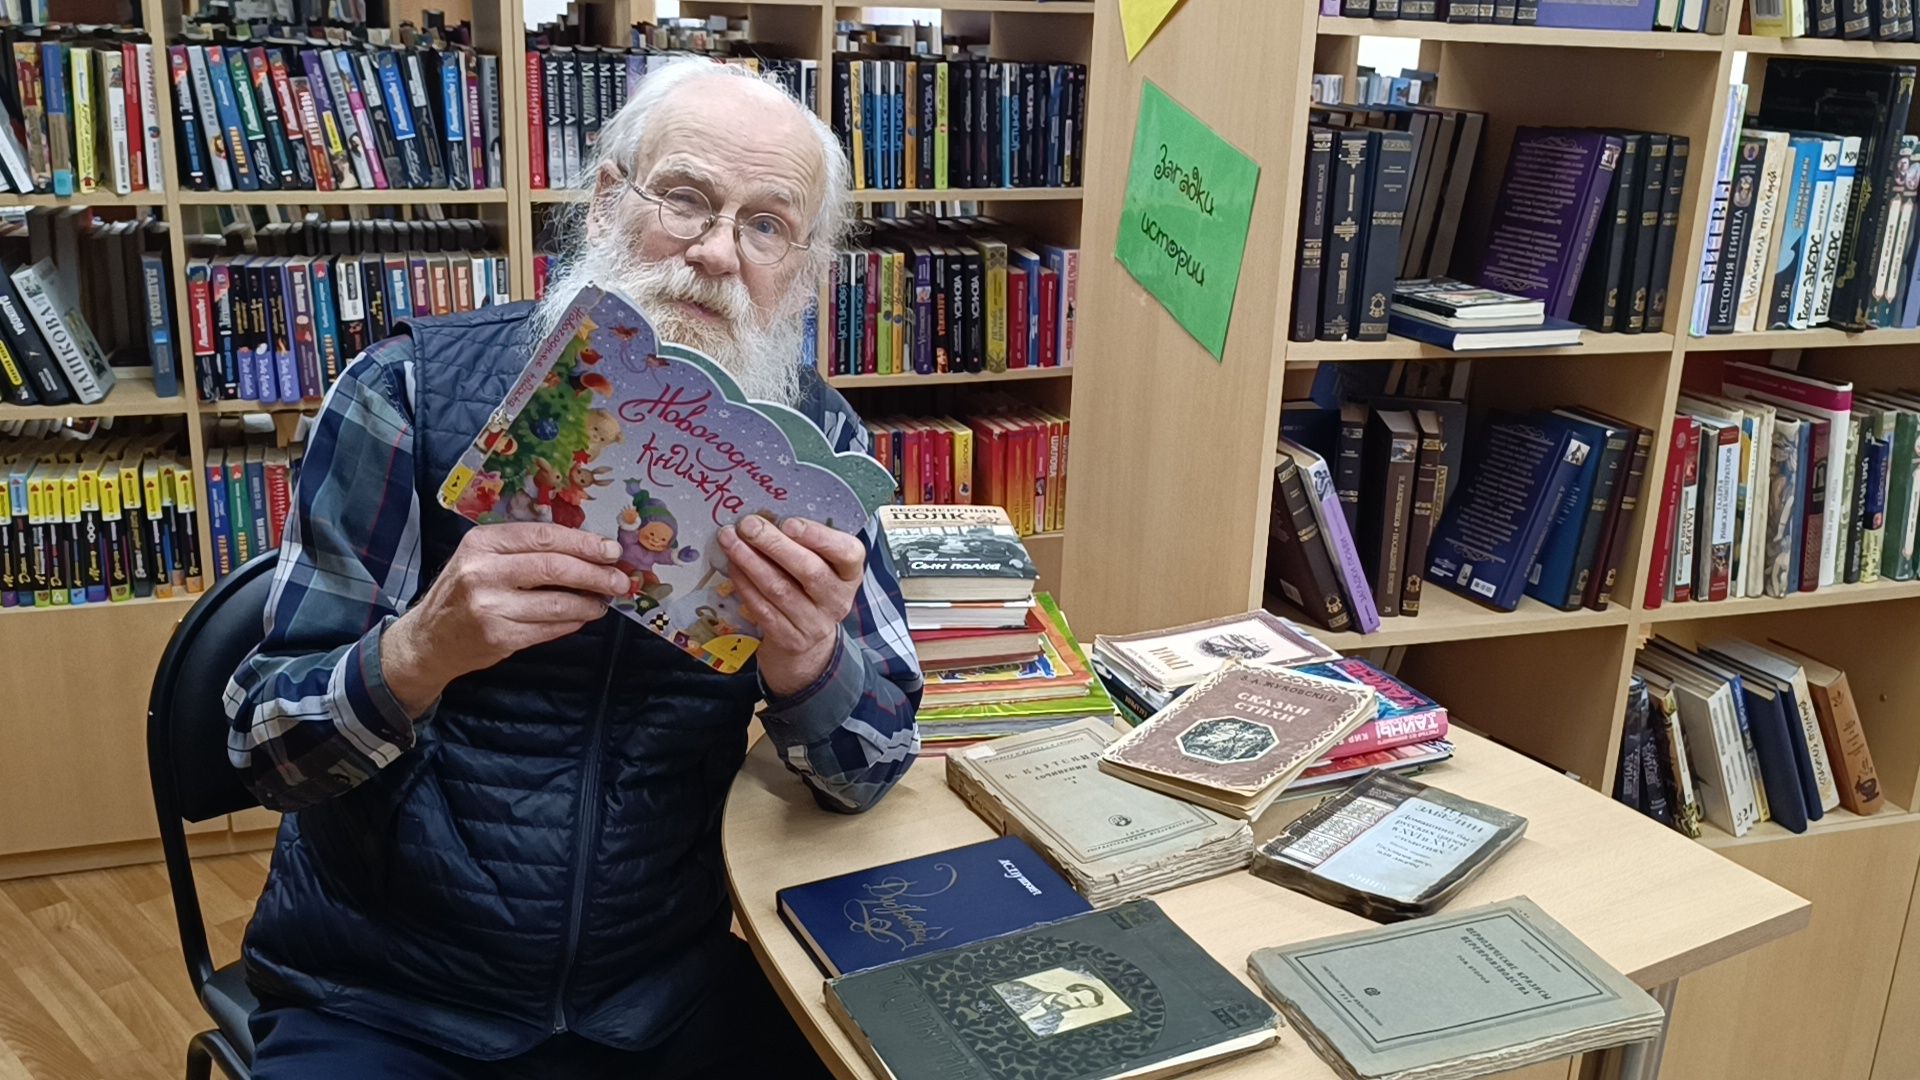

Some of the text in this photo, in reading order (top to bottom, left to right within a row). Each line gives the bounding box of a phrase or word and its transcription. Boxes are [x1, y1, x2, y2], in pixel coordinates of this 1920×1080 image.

[1701, 181, 1731, 284] БИТВЫ
[1718, 210, 1744, 323] ИСТОРИЯ ЕГИПТА
[38, 300, 99, 397] ДАШКОВА
[618, 384, 789, 502] Новогодняя
[892, 512, 966, 520] ПОЛК
[1233, 702, 1296, 724] СТИХИ
[1237, 691, 1312, 717] СКАЗКИ
